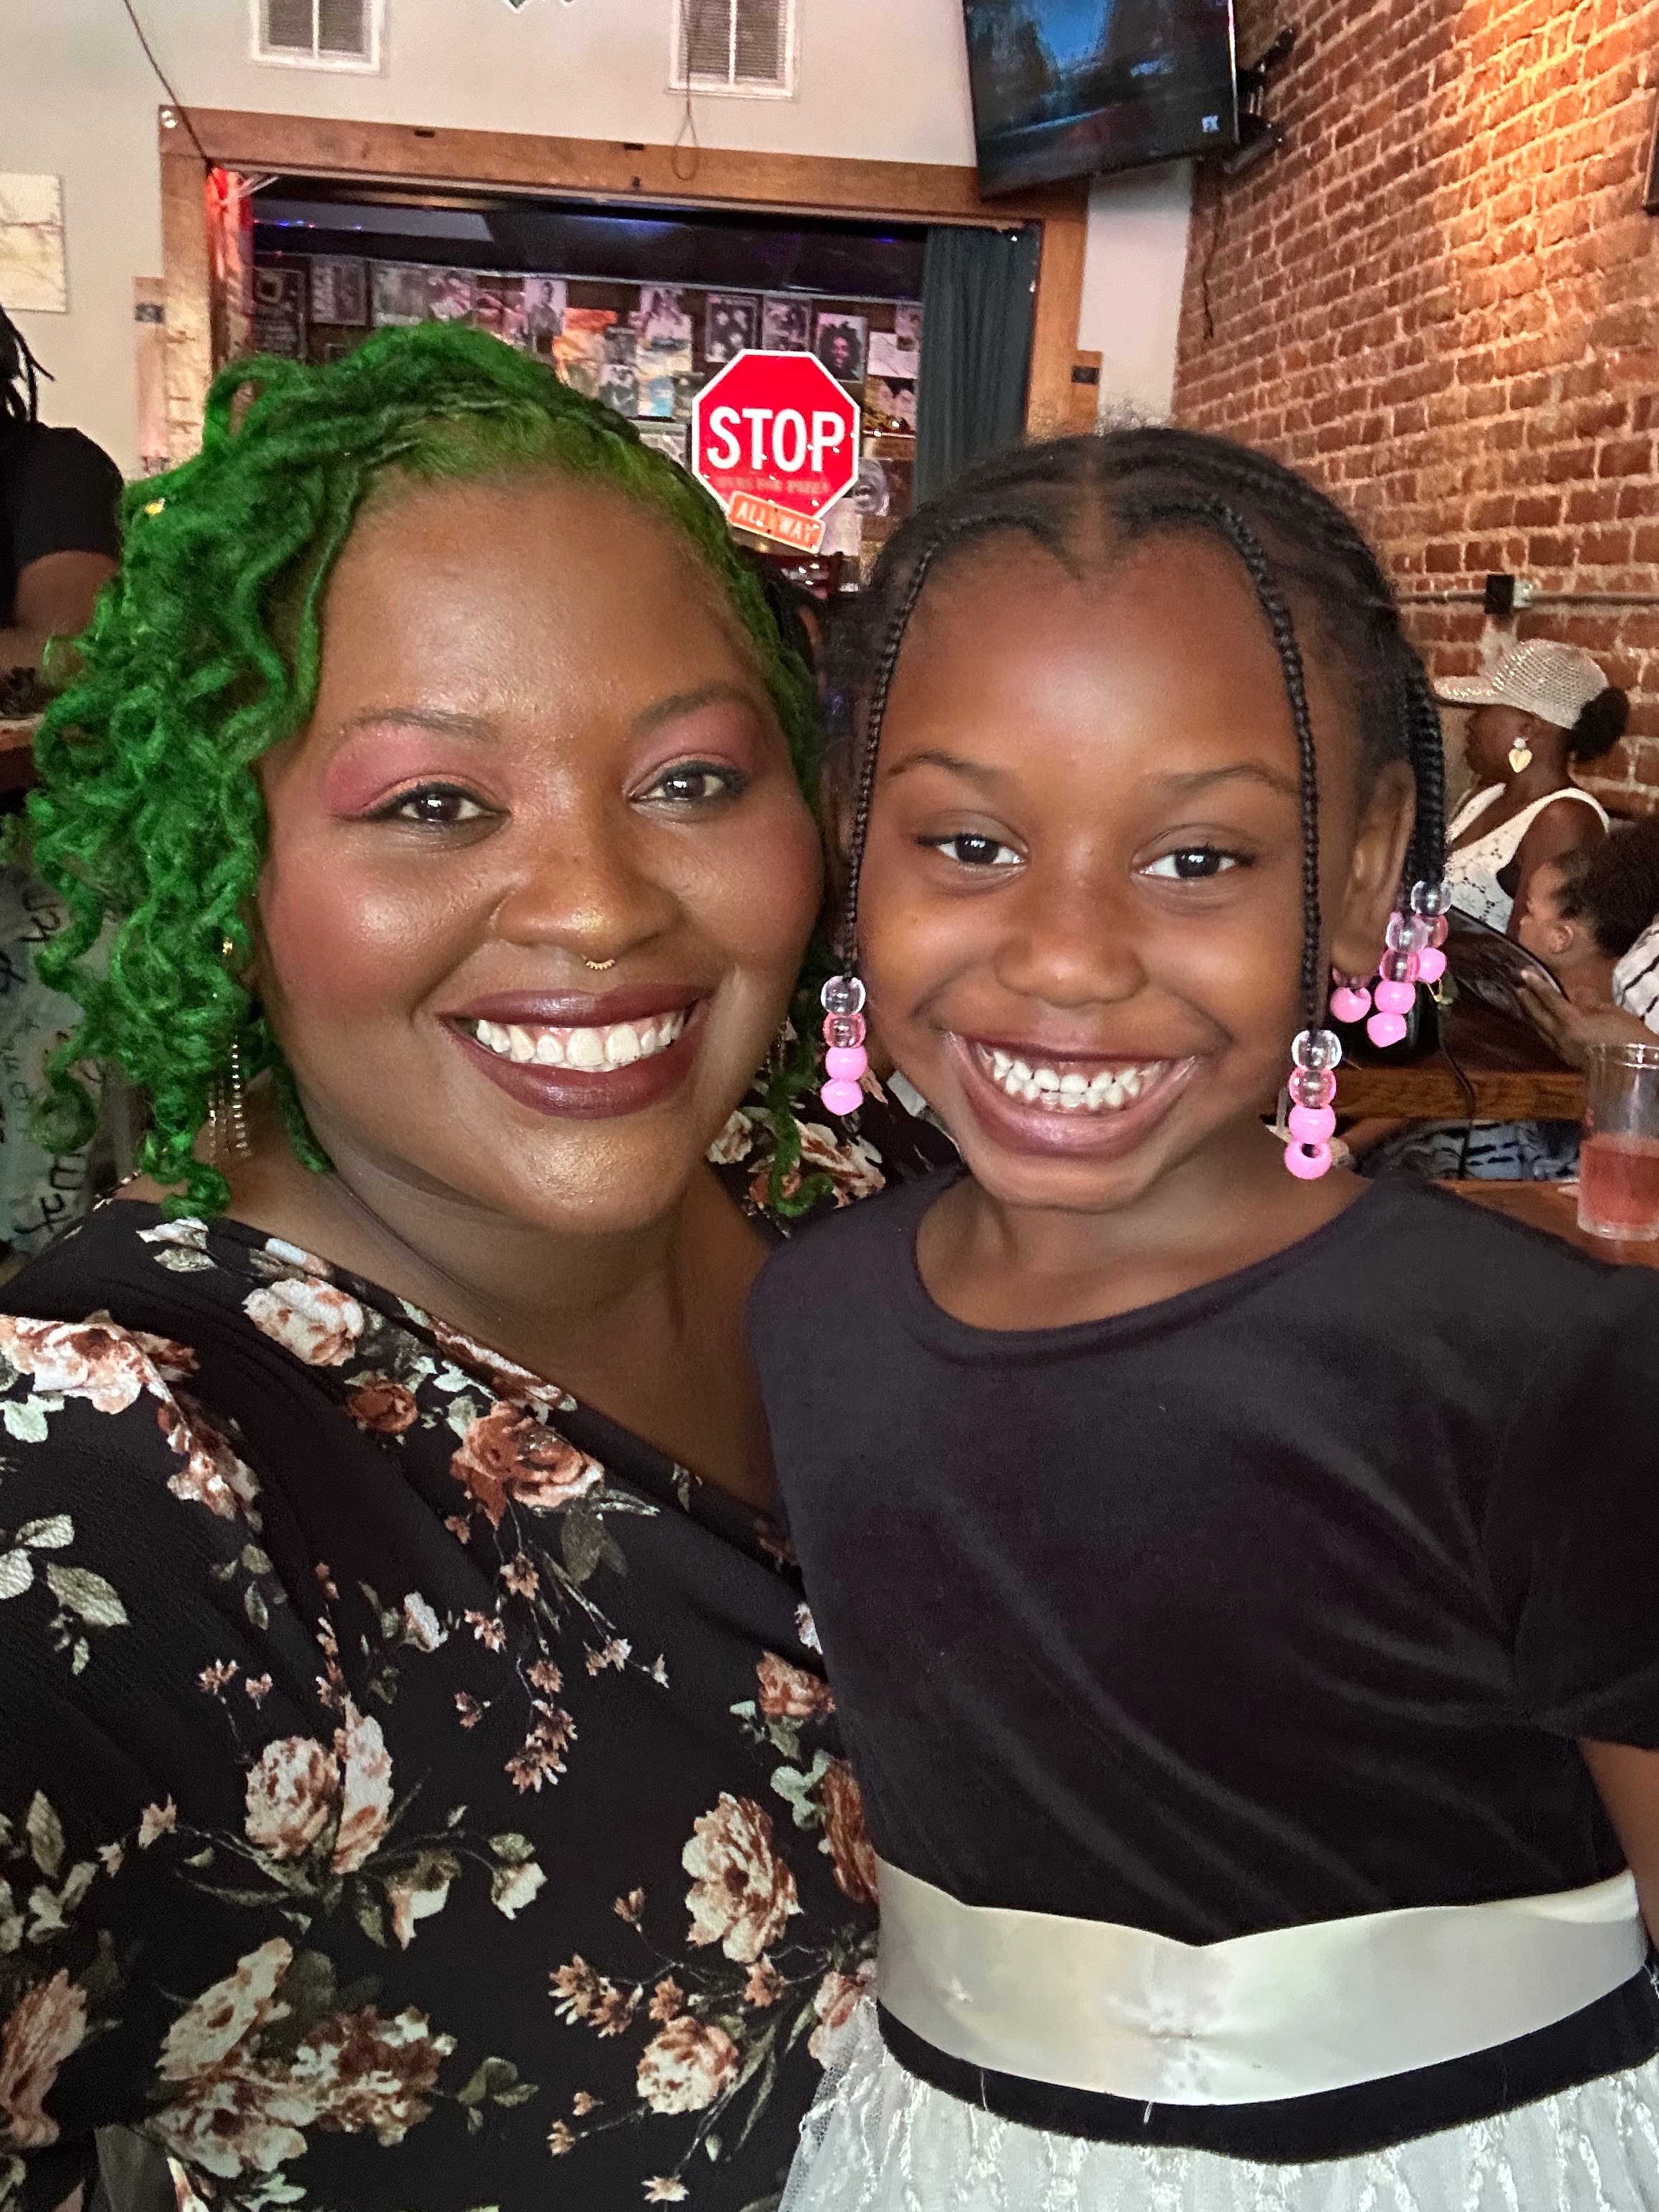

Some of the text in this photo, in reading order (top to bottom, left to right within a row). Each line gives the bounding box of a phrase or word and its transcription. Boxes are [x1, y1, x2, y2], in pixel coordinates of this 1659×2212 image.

[707, 406, 846, 472] STOP
[736, 501, 818, 542] ALL WAY
